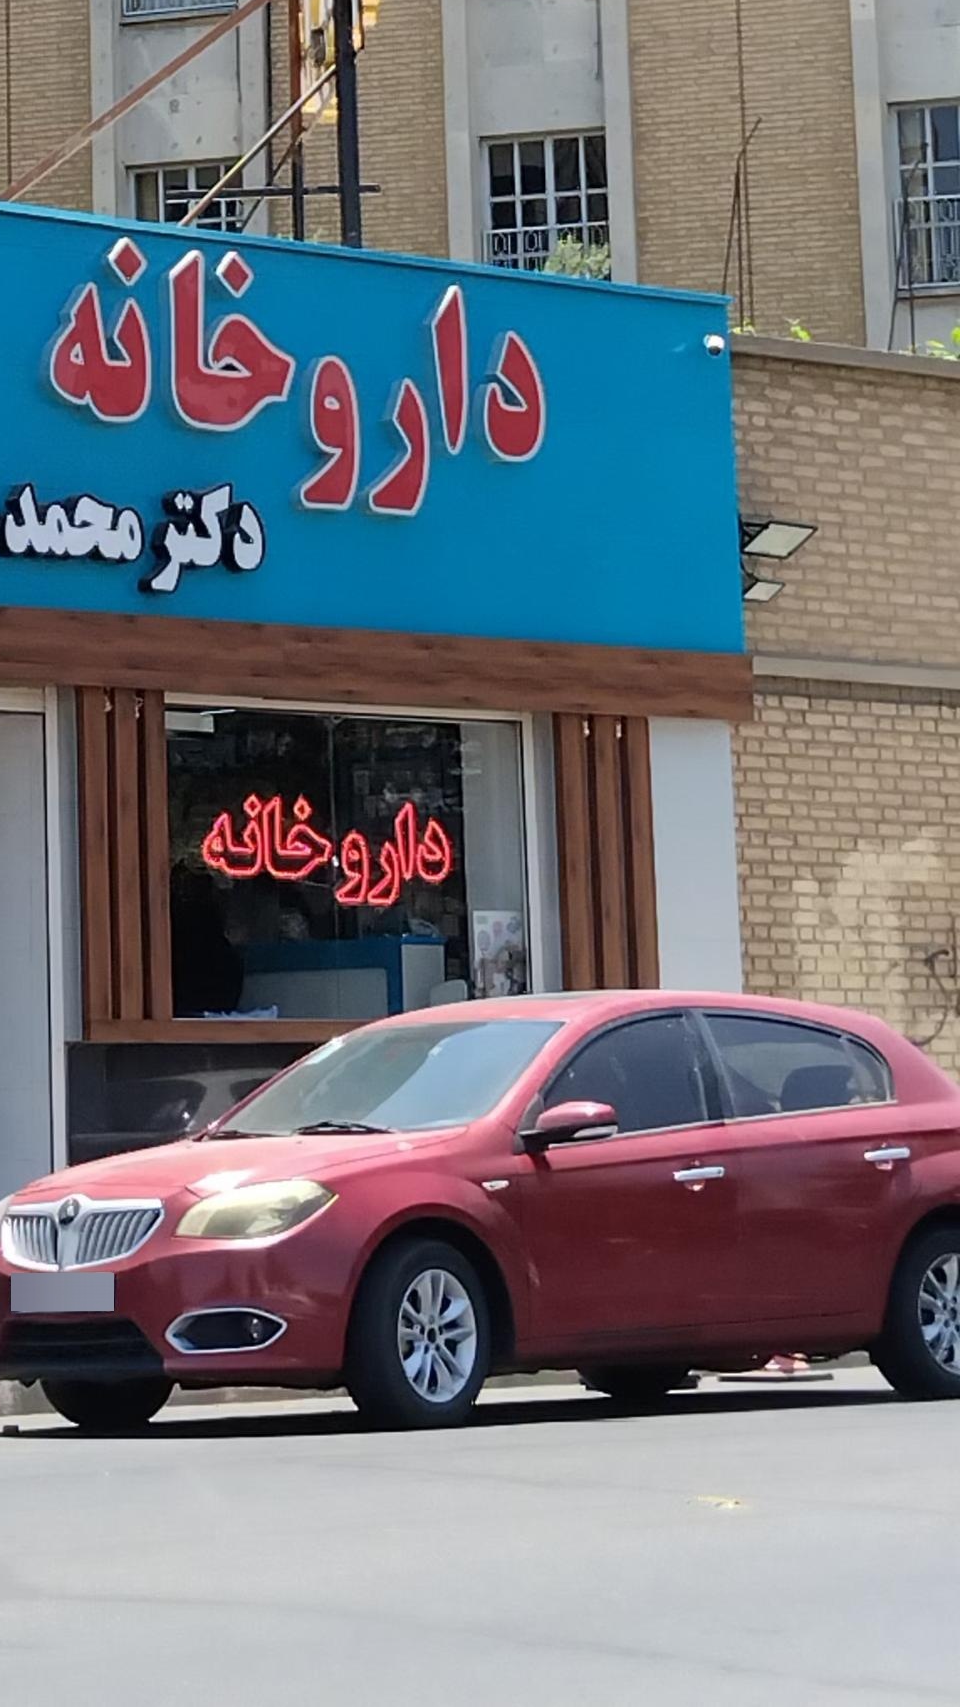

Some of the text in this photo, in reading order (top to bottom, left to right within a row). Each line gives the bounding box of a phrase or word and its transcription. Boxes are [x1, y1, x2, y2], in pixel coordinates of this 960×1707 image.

[49, 237, 545, 516] داروخانه
[139, 484, 264, 593] دکتر
[201, 793, 452, 907] داروخانه
